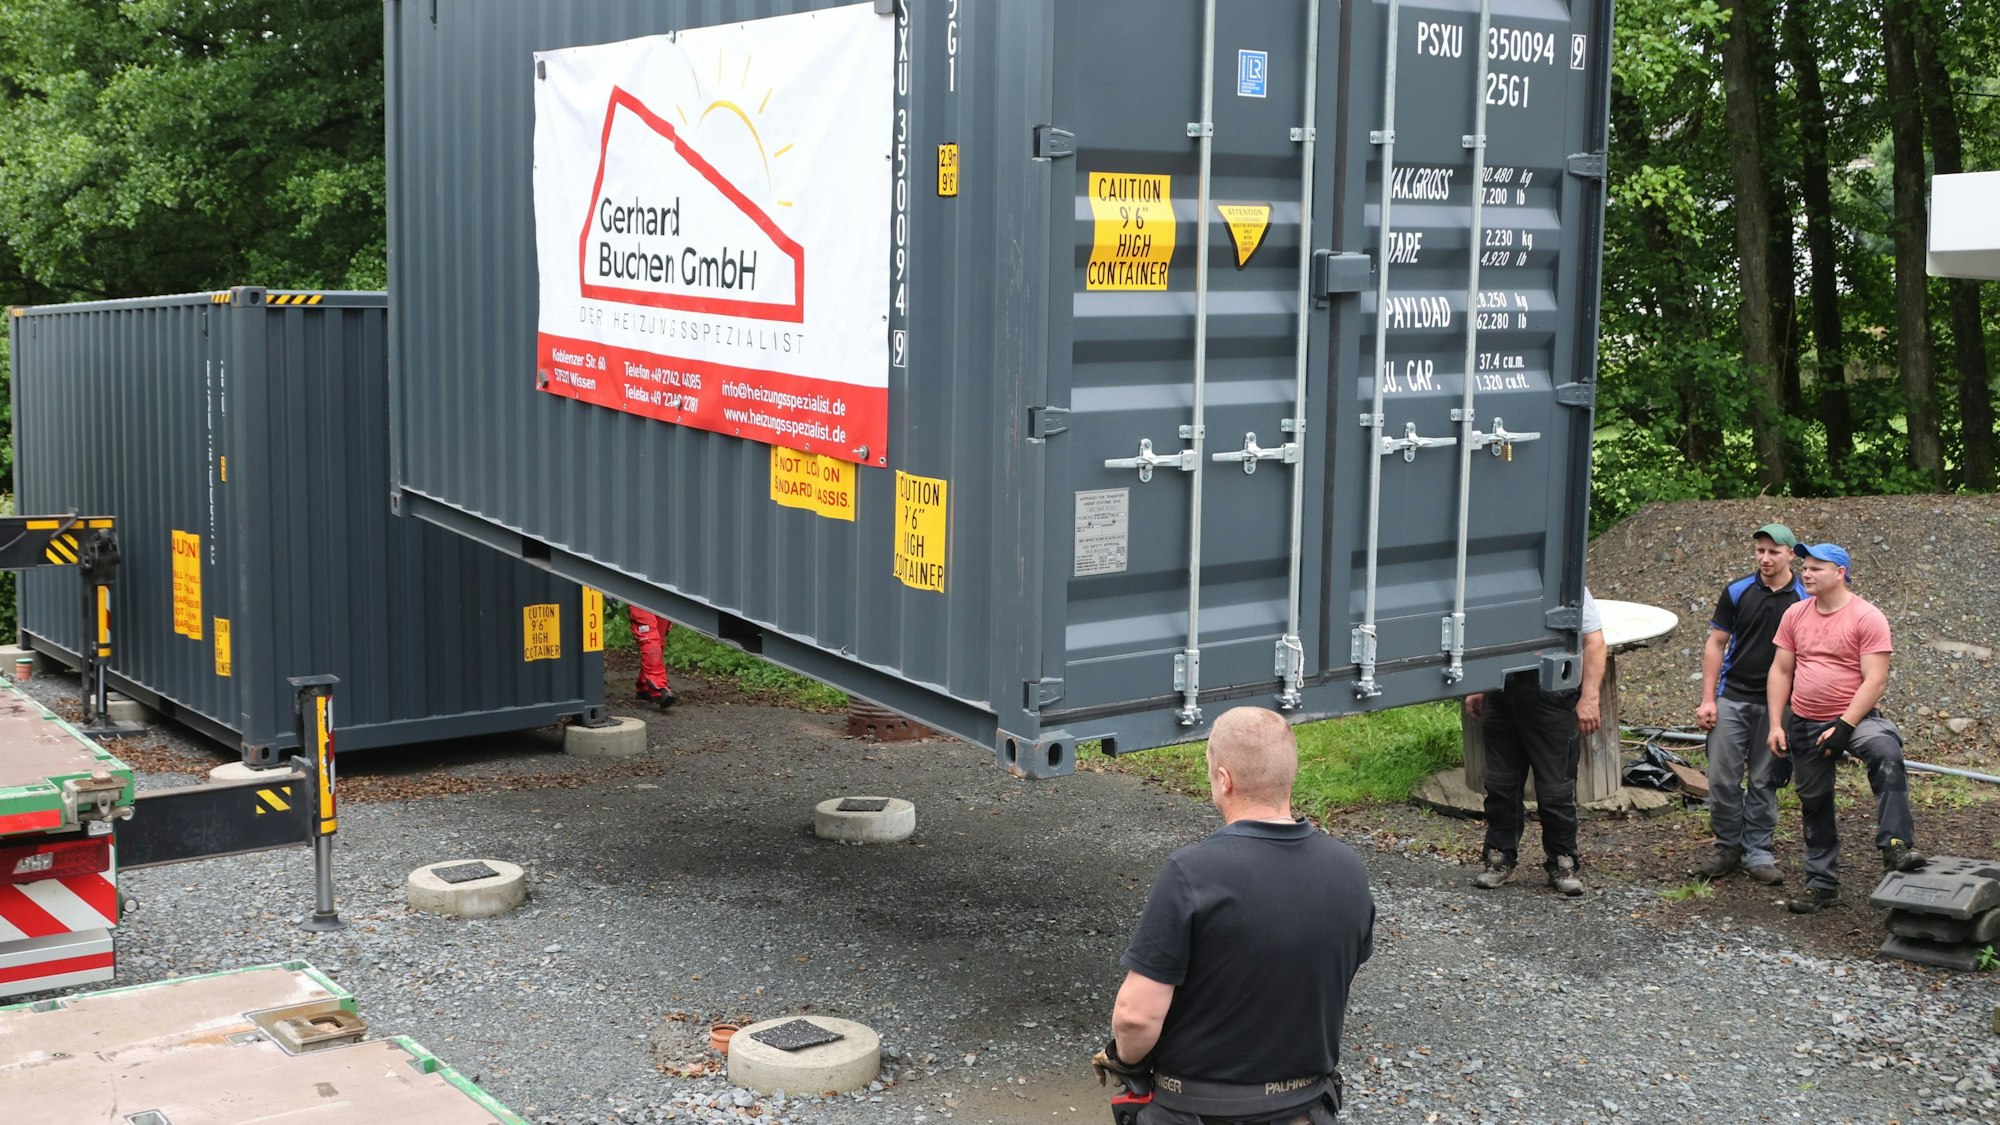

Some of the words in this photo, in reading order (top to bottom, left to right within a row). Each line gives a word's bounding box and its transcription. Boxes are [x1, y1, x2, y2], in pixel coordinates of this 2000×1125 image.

[1417, 21, 1463, 58] PSXU
[1487, 27, 1555, 65] 350094
[1572, 35, 1585, 68] 9
[1486, 72, 1530, 108] 25G1
[1098, 177, 1161, 203] CAUTION
[1519, 168, 1533, 188] kg
[1481, 187, 1508, 205] 7.200
[1516, 188, 1525, 206] lb
[600, 196, 680, 237] Gerhard
[895, 109, 907, 316] 350094
[1228, 208, 1264, 216] ATTENTION
[1116, 234, 1151, 258] HIGH
[1389, 232, 1423, 264] TARE
[1485, 229, 1513, 247] 2.230
[1521, 230, 1533, 250] kg
[1480, 251, 1510, 267] 4.920
[1516, 252, 1527, 267] lb
[599, 242, 675, 284] Buchen
[681, 247, 757, 291] GmbH
[1088, 261, 1168, 286] CONTAINER
[1386, 296, 1451, 329] PAYLOAD
[1477, 292, 1508, 309] 8.250
[1514, 293, 1528, 312] kg
[1476, 313, 1509, 330] 62.280
[1518, 314, 1527, 329] lb
[580, 306, 603, 326] DER
[613, 311, 804, 354] HEIZUNGSSPEZIALIST
[552, 347, 584, 367] Koblenzer
[586, 353, 597, 369] Str.
[598, 356, 607, 371] 60
[894, 332, 905, 366] 9
[570, 370, 596, 390] Wissen
[624, 361, 650, 380] Telefon
[651, 367, 662, 382] +49
[662, 369, 681, 387] 2742
[682, 372, 702, 390] 4085
[1406, 360, 1441, 391] CAP.
[1479, 353, 1500, 370] 37.4
[1502, 354, 1525, 369] cu.m.
[1505, 374, 1530, 390] cu.ft.
[624, 383, 650, 403] Telefax
[650, 390, 662, 405] +49
[684, 395, 699, 413] 2781
[722, 380, 846, 416] info@heizungsspezialist.de
[723, 408, 846, 443] www.heizungsspezialist.de
[779, 455, 801, 473] NOT
[823, 467, 840, 483] ON
